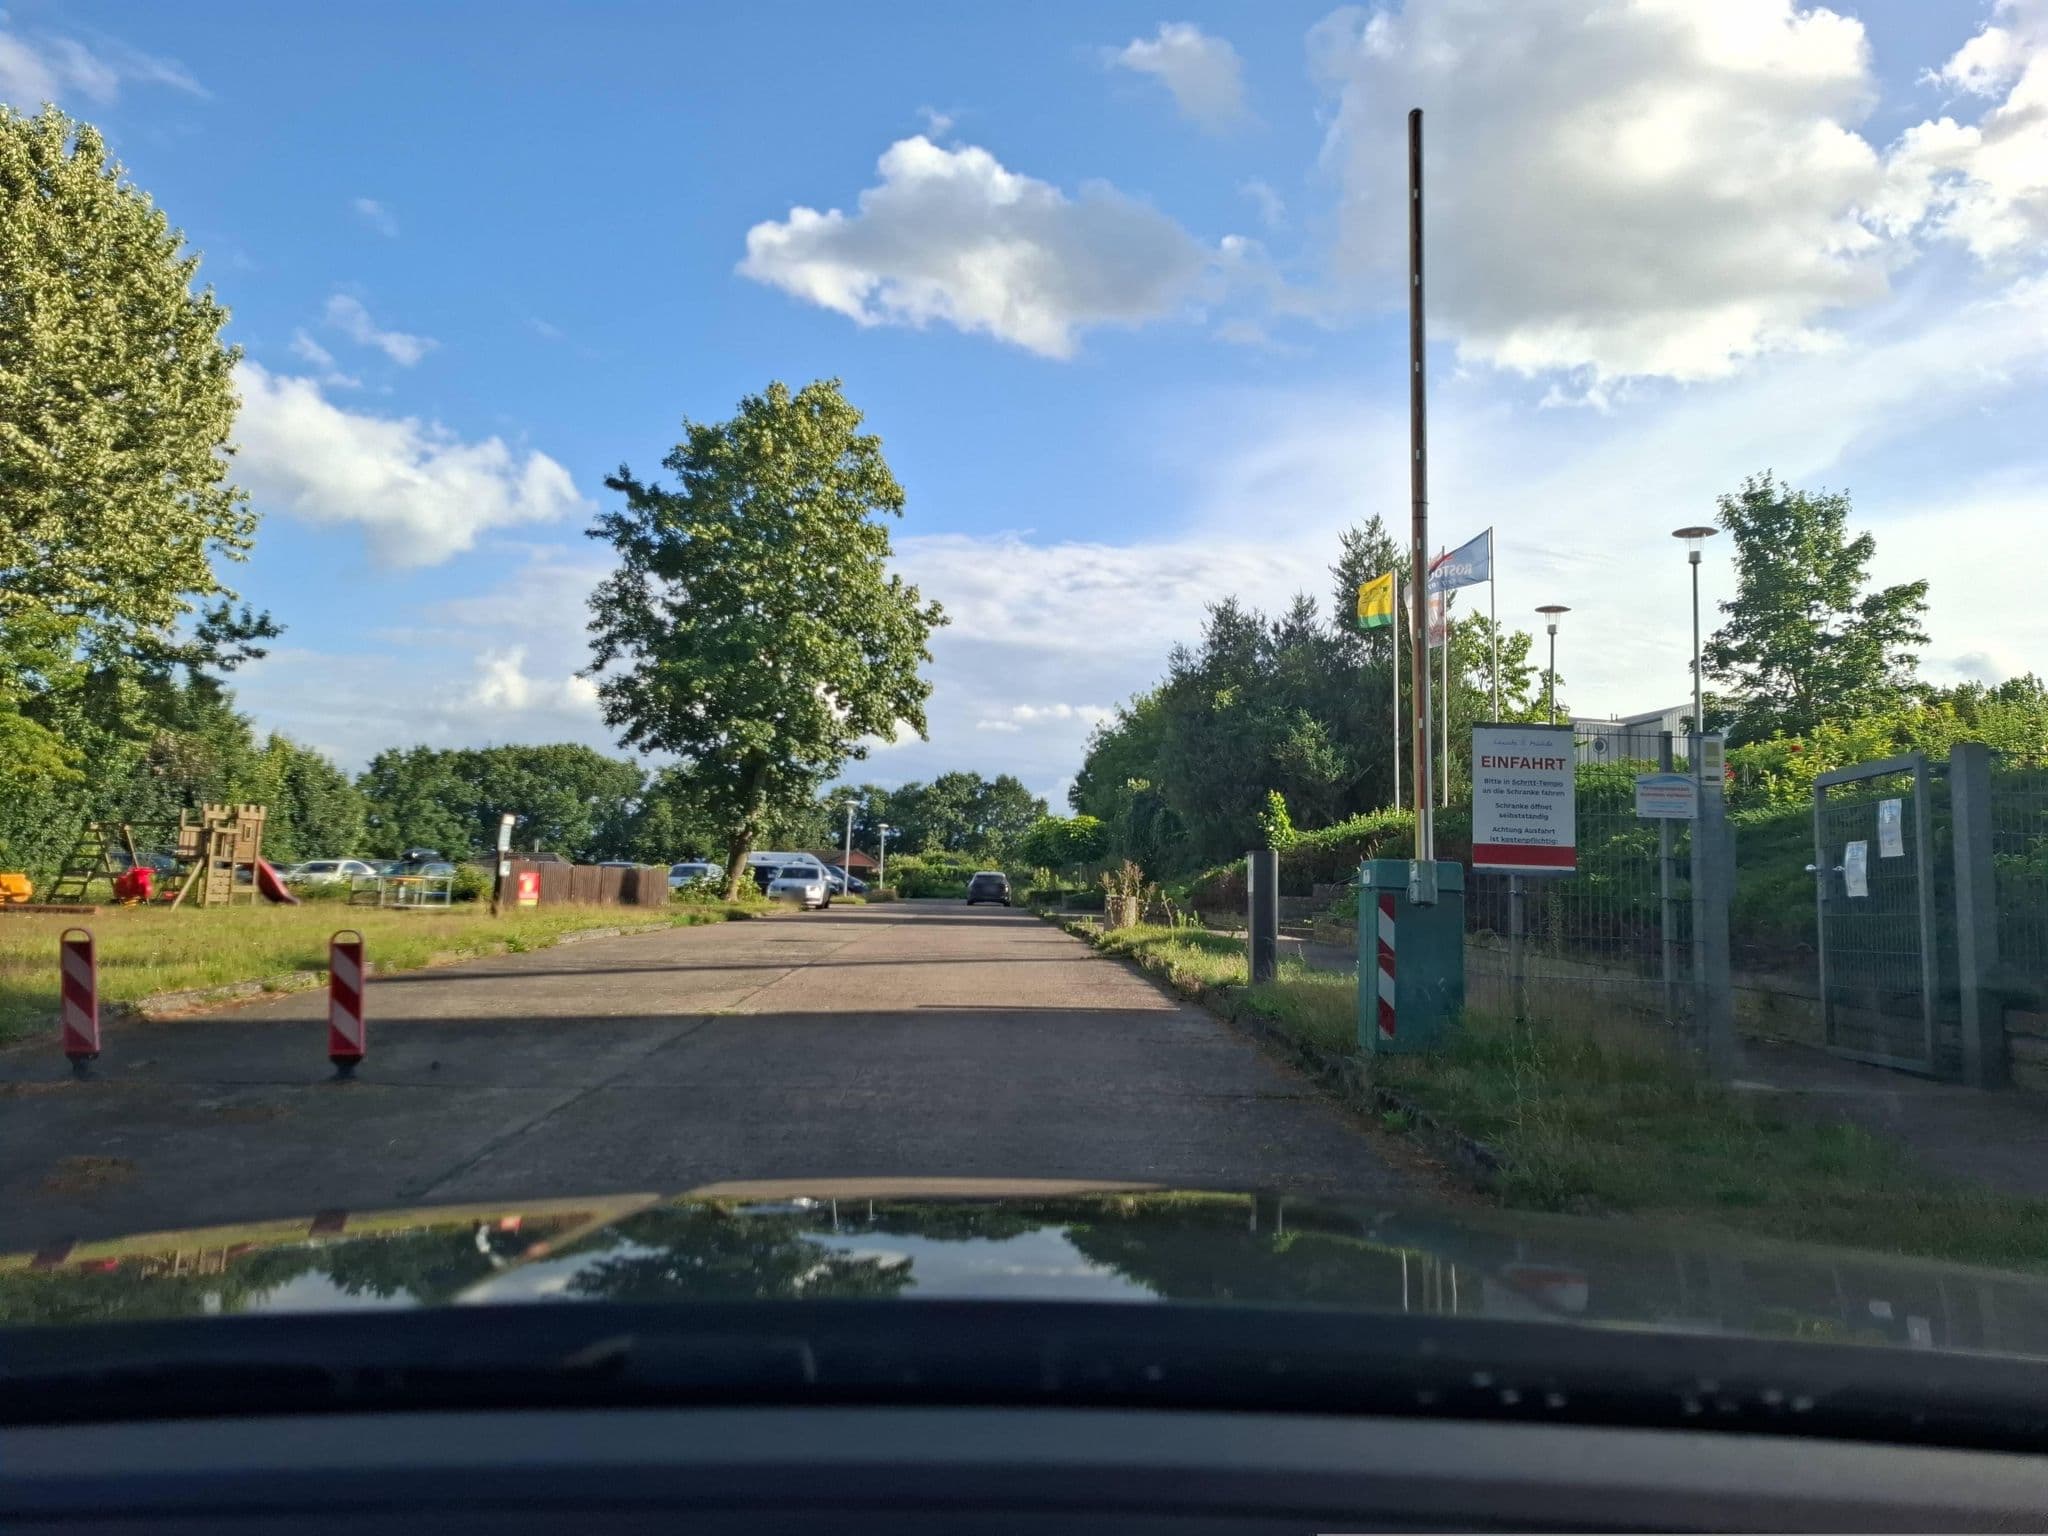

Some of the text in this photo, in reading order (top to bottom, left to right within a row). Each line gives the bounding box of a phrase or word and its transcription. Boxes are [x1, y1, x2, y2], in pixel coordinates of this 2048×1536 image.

[1481, 756, 1566, 770] EINFAHRT
[1512, 778, 1563, 787] Schritt-Tempo
[1495, 802, 1552, 811] Schranke öffnet
[1492, 826, 1523, 834] Achtung
[1490, 834, 1499, 842] ist
